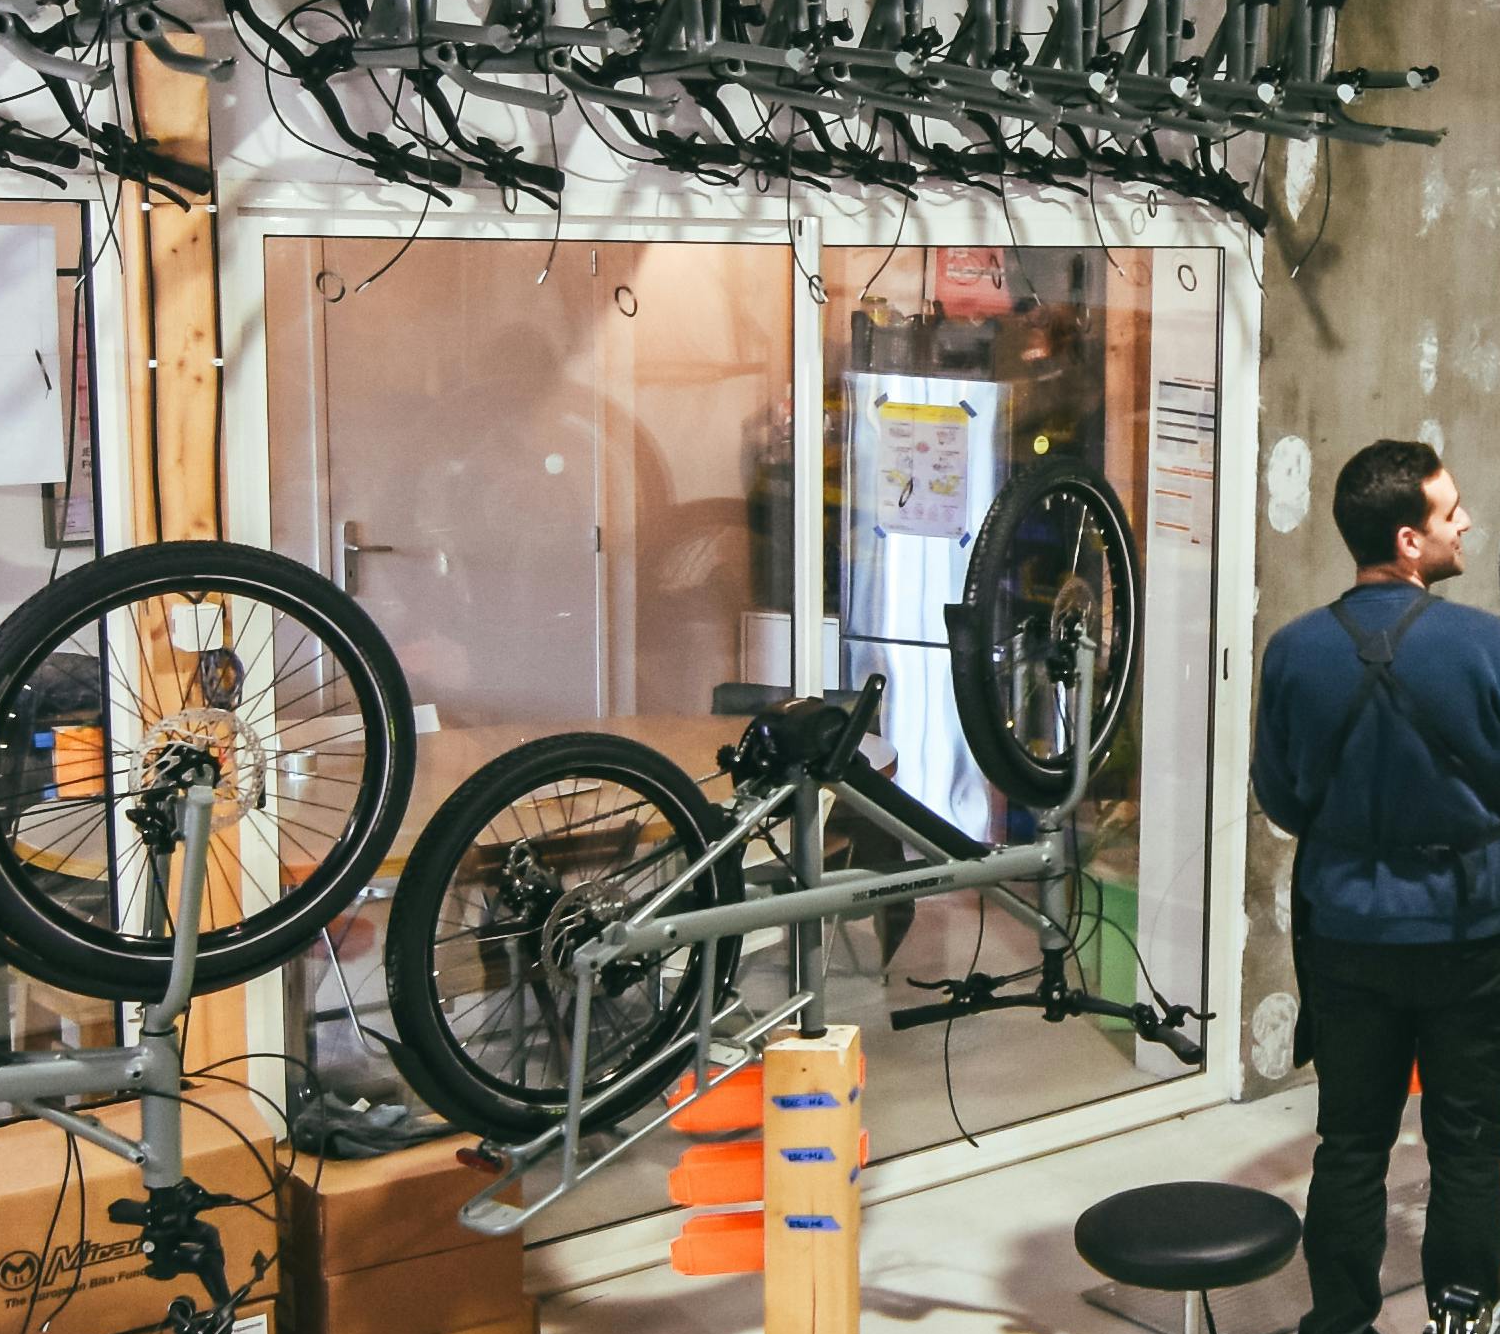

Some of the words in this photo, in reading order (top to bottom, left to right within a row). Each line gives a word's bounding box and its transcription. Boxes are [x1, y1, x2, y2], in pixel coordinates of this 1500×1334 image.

[41, 1239, 143, 1287] Miran
[5, 1293, 27, 1309] The
[90, 1274, 116, 1289] Bike
